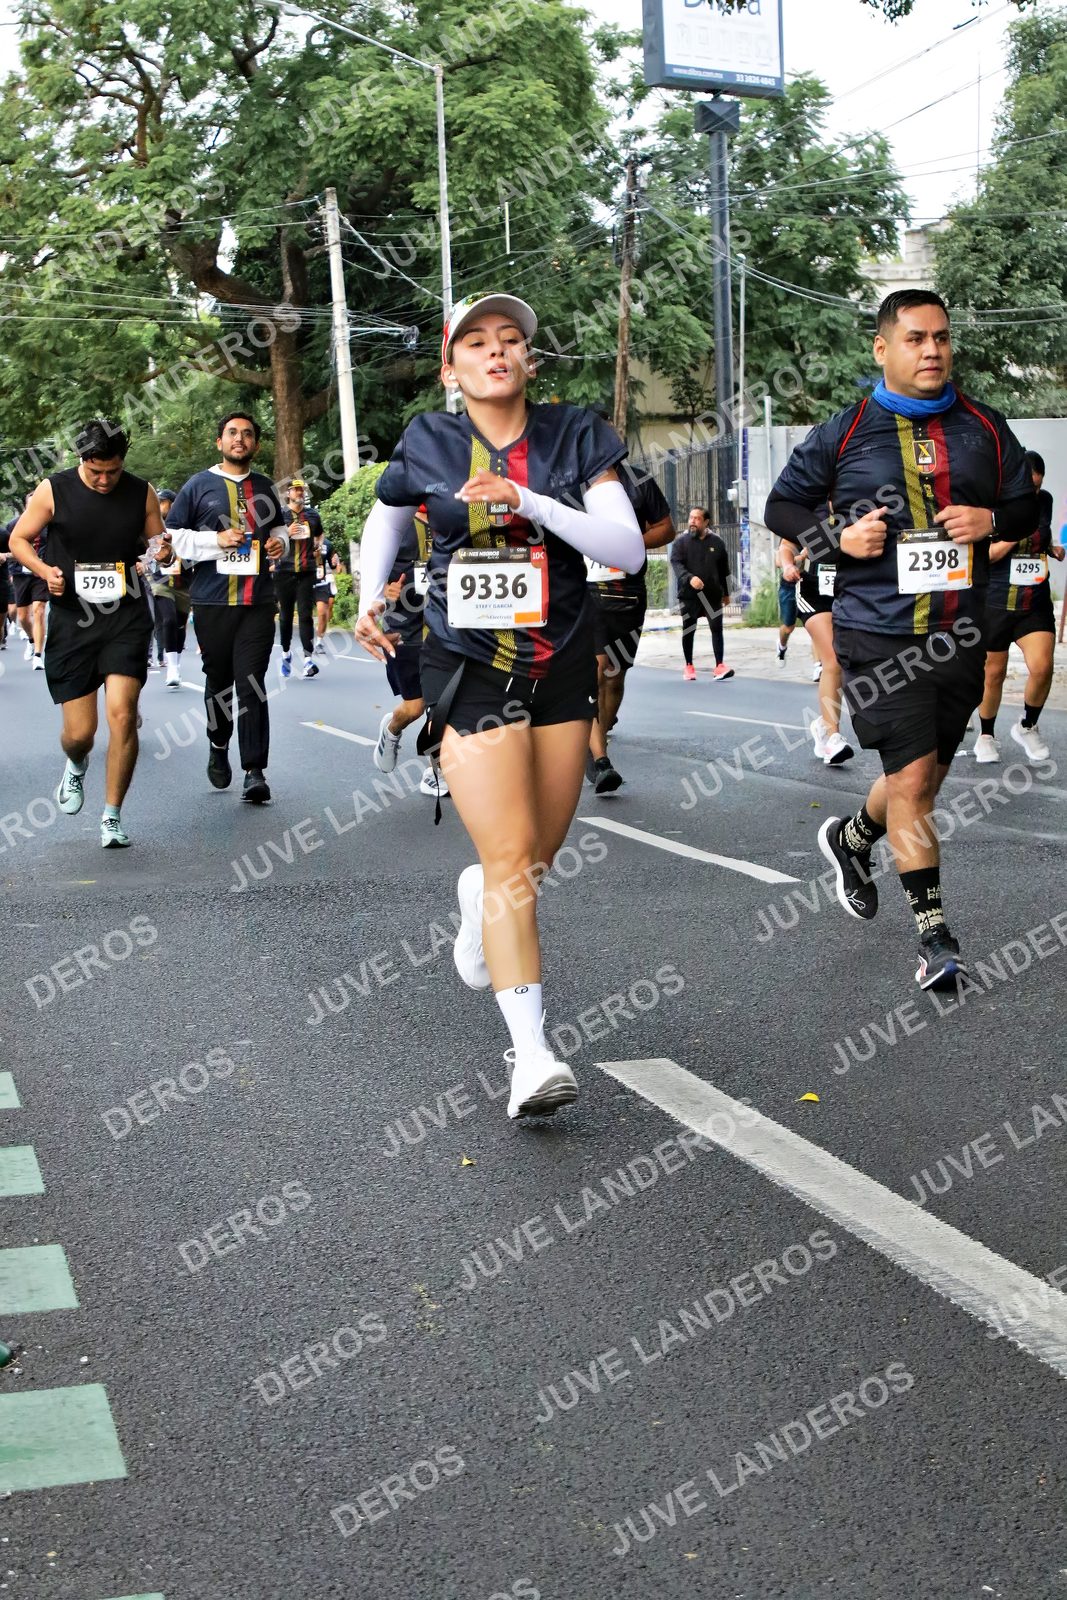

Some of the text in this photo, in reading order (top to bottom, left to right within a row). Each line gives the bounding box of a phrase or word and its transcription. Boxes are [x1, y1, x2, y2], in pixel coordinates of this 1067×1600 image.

[908, 549, 960, 572] 2398
[1016, 562, 1041, 574] 4295
[82, 576, 116, 590] 5798
[460, 573, 528, 600] 9336
